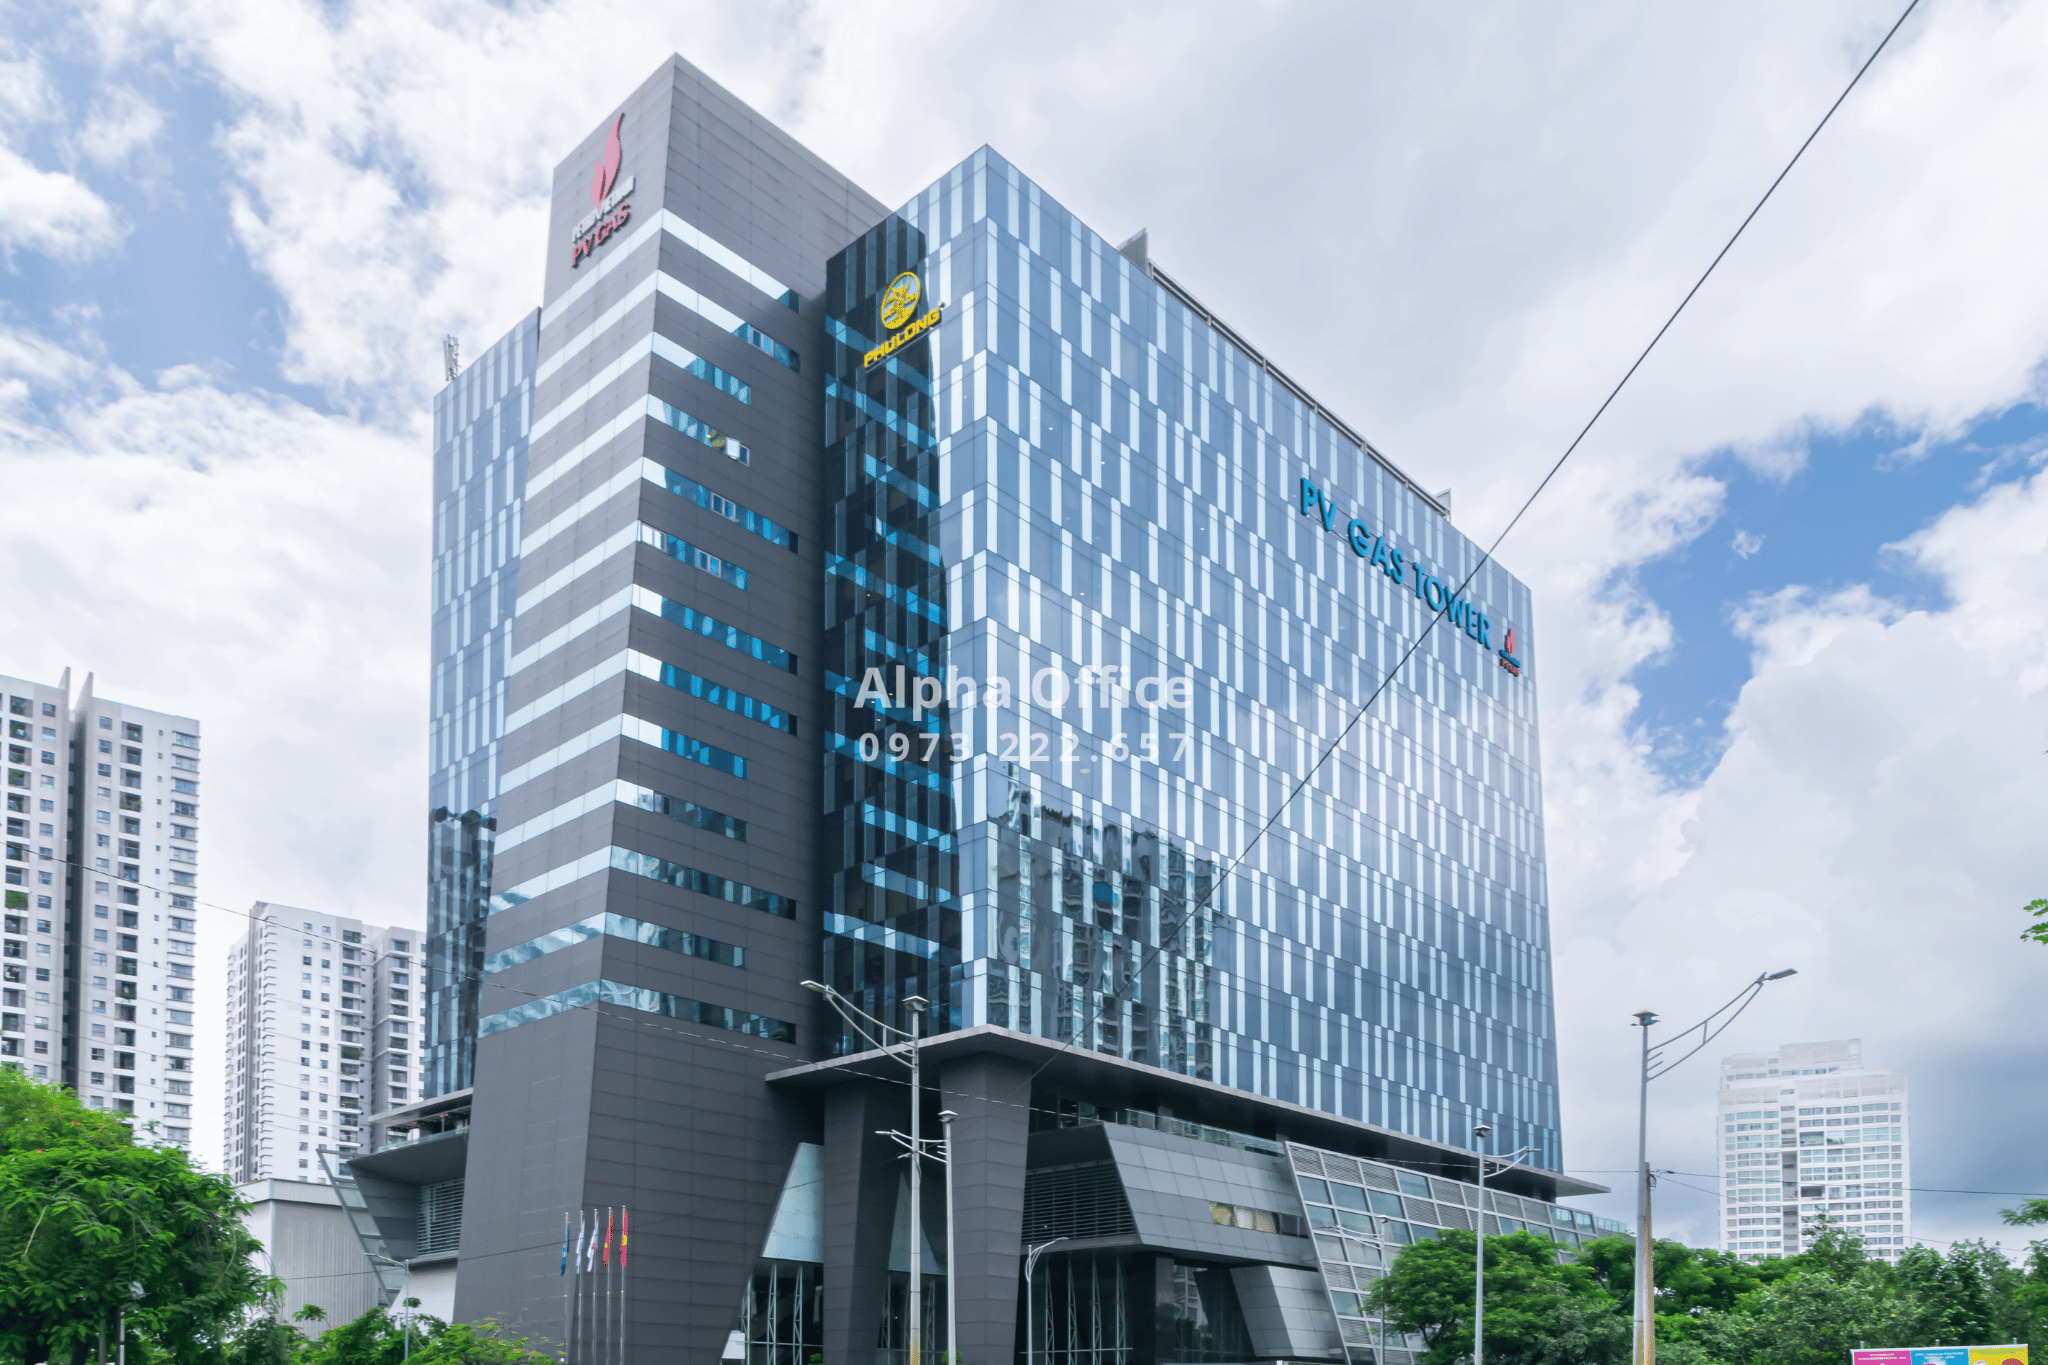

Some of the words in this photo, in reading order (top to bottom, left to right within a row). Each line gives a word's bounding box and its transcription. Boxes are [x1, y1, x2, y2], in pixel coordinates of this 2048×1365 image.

[1300, 477, 1337, 532] PV
[1347, 518, 1404, 584] GAS
[1412, 562, 1492, 650] TOWER
